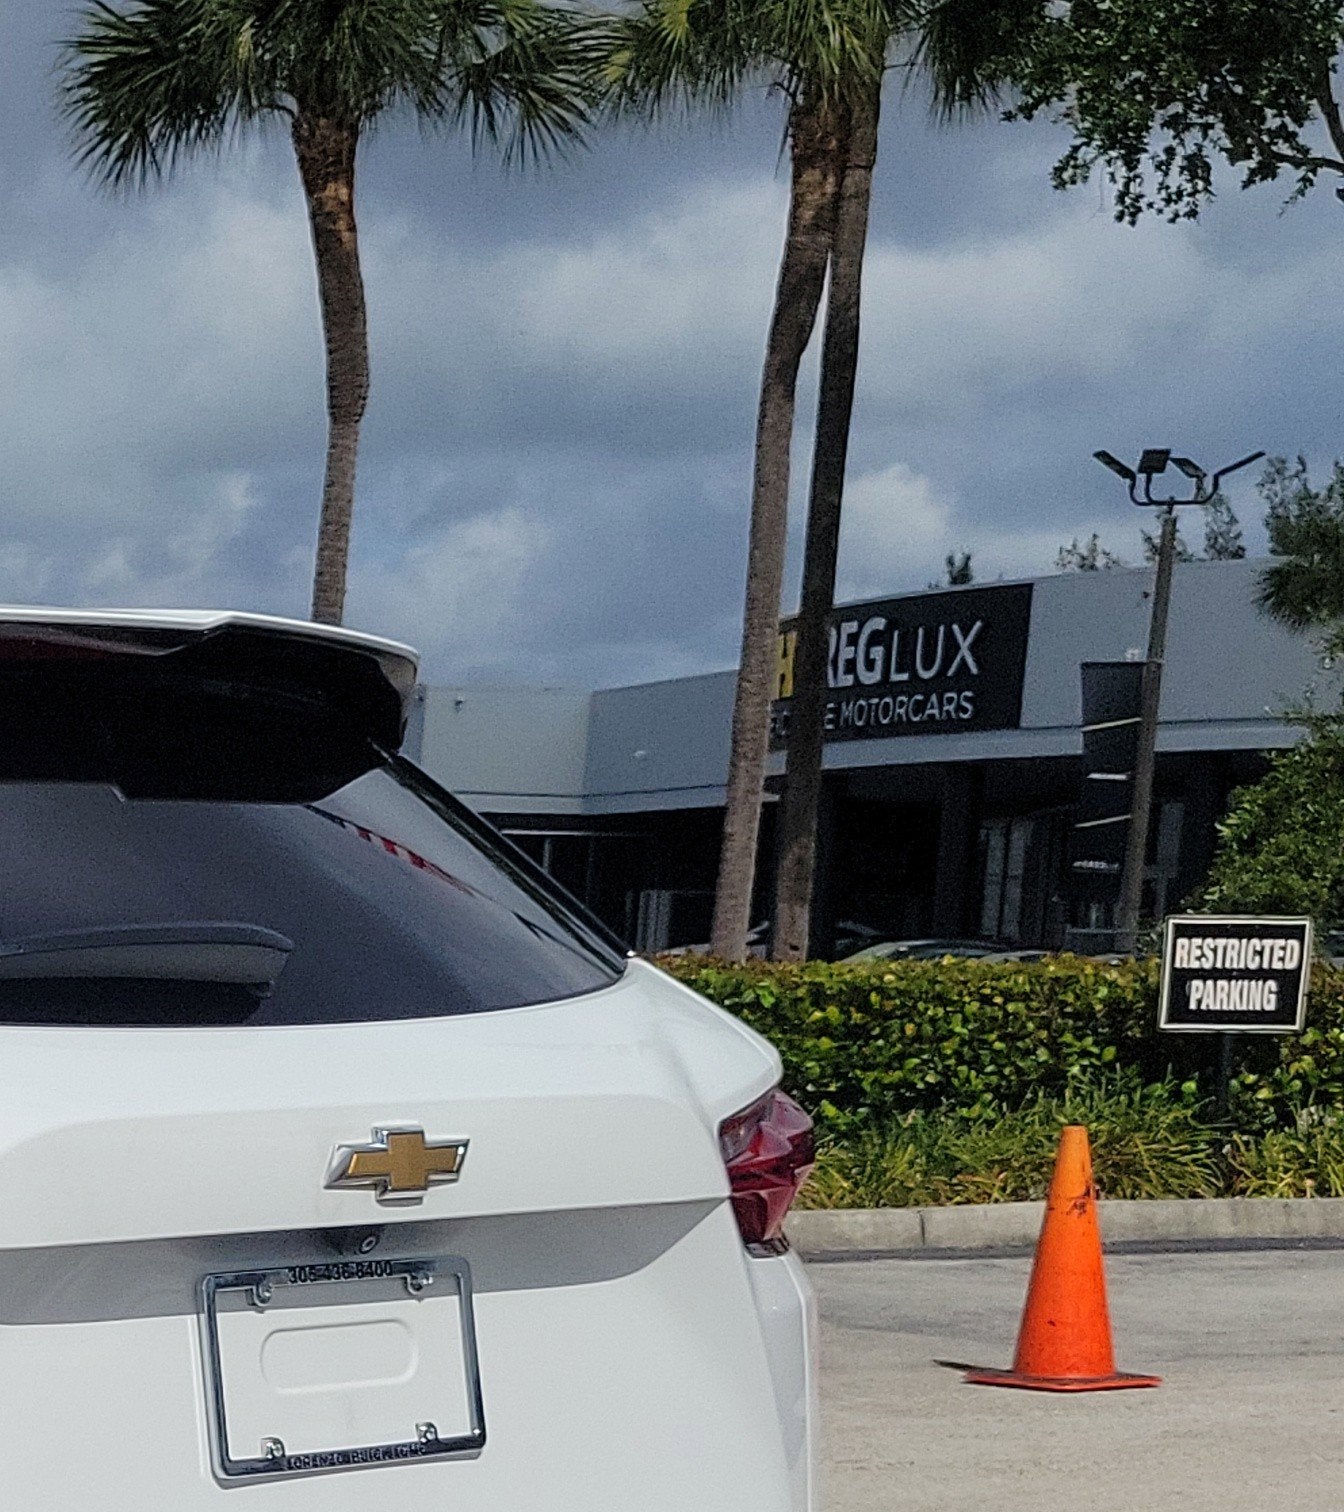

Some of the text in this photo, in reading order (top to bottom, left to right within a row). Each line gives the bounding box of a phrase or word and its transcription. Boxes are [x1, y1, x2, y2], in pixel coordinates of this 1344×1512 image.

[840, 690, 976, 729] MOTORCARS
[1173, 937, 1301, 970] RESTRICTED
[1188, 979, 1278, 1011] PARKING
